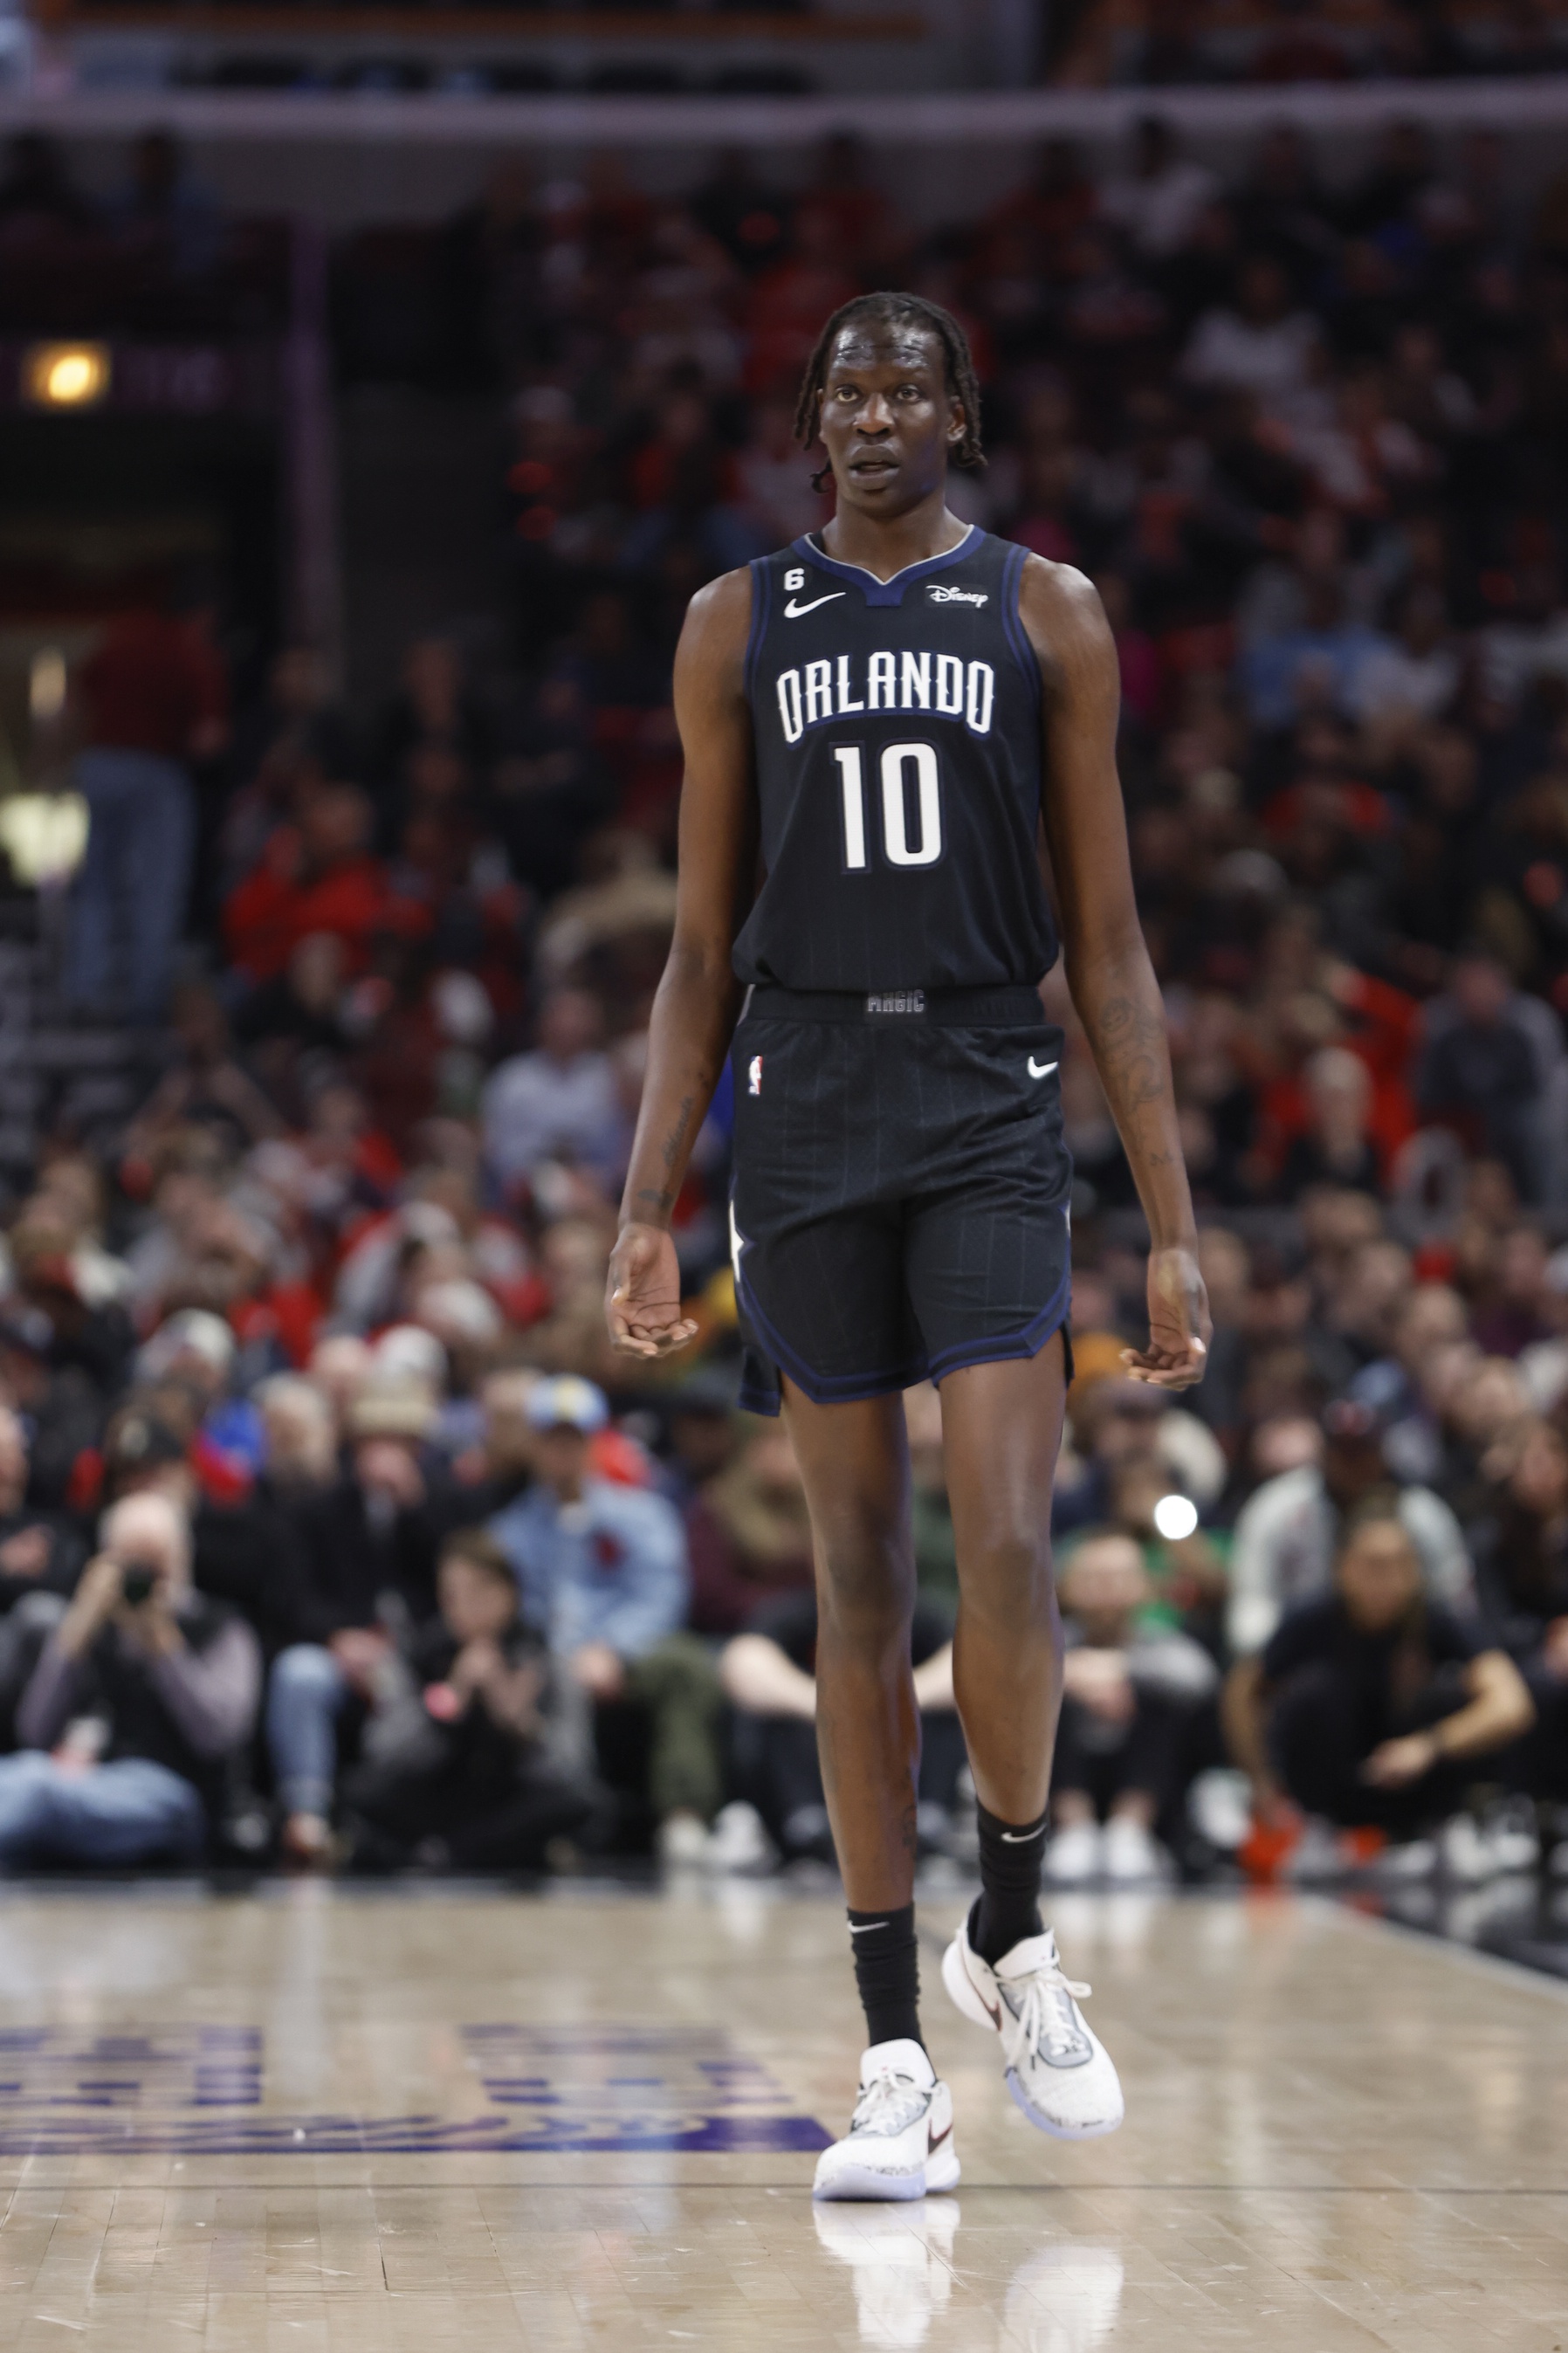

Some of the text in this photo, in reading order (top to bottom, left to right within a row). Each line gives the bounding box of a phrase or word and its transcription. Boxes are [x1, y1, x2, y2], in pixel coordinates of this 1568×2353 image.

[785, 568, 805, 590] 6
[925, 585, 988, 608] Disney
[777, 650, 994, 743] ORLANDO
[834, 742, 941, 868] 10
